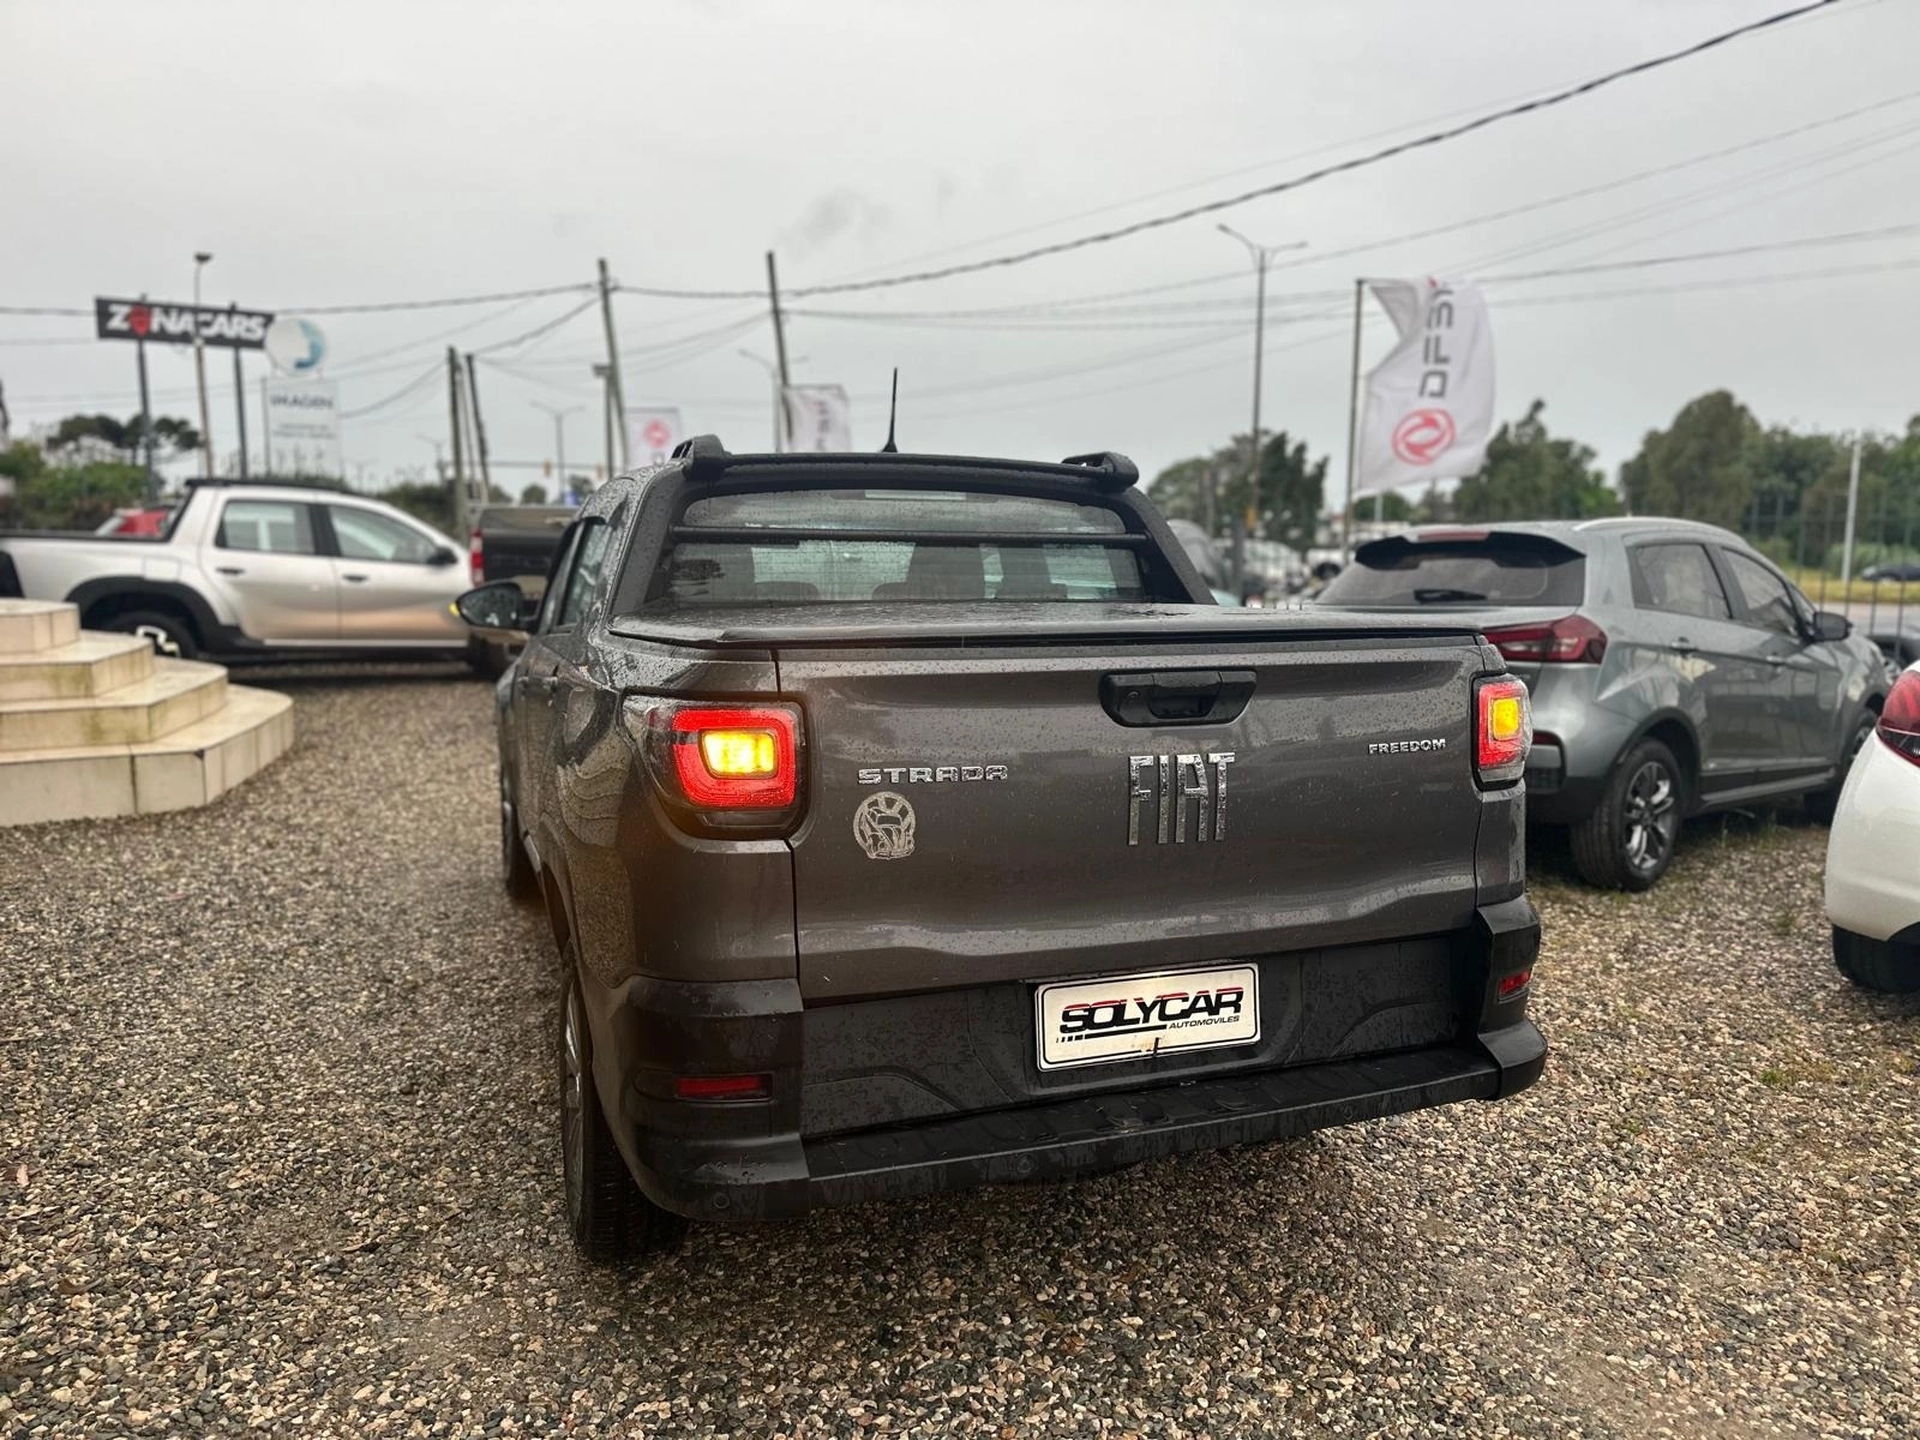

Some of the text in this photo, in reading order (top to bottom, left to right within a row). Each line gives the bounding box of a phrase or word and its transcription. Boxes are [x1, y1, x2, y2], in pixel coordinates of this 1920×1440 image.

[1368, 739, 1446, 754] FREEDOM
[858, 764, 1008, 785] STRADA
[1128, 752, 1235, 845] FIAT
[1059, 986, 1244, 1034] SOLYCAR
[1169, 1014, 1241, 1030] AUTOMOVILES
